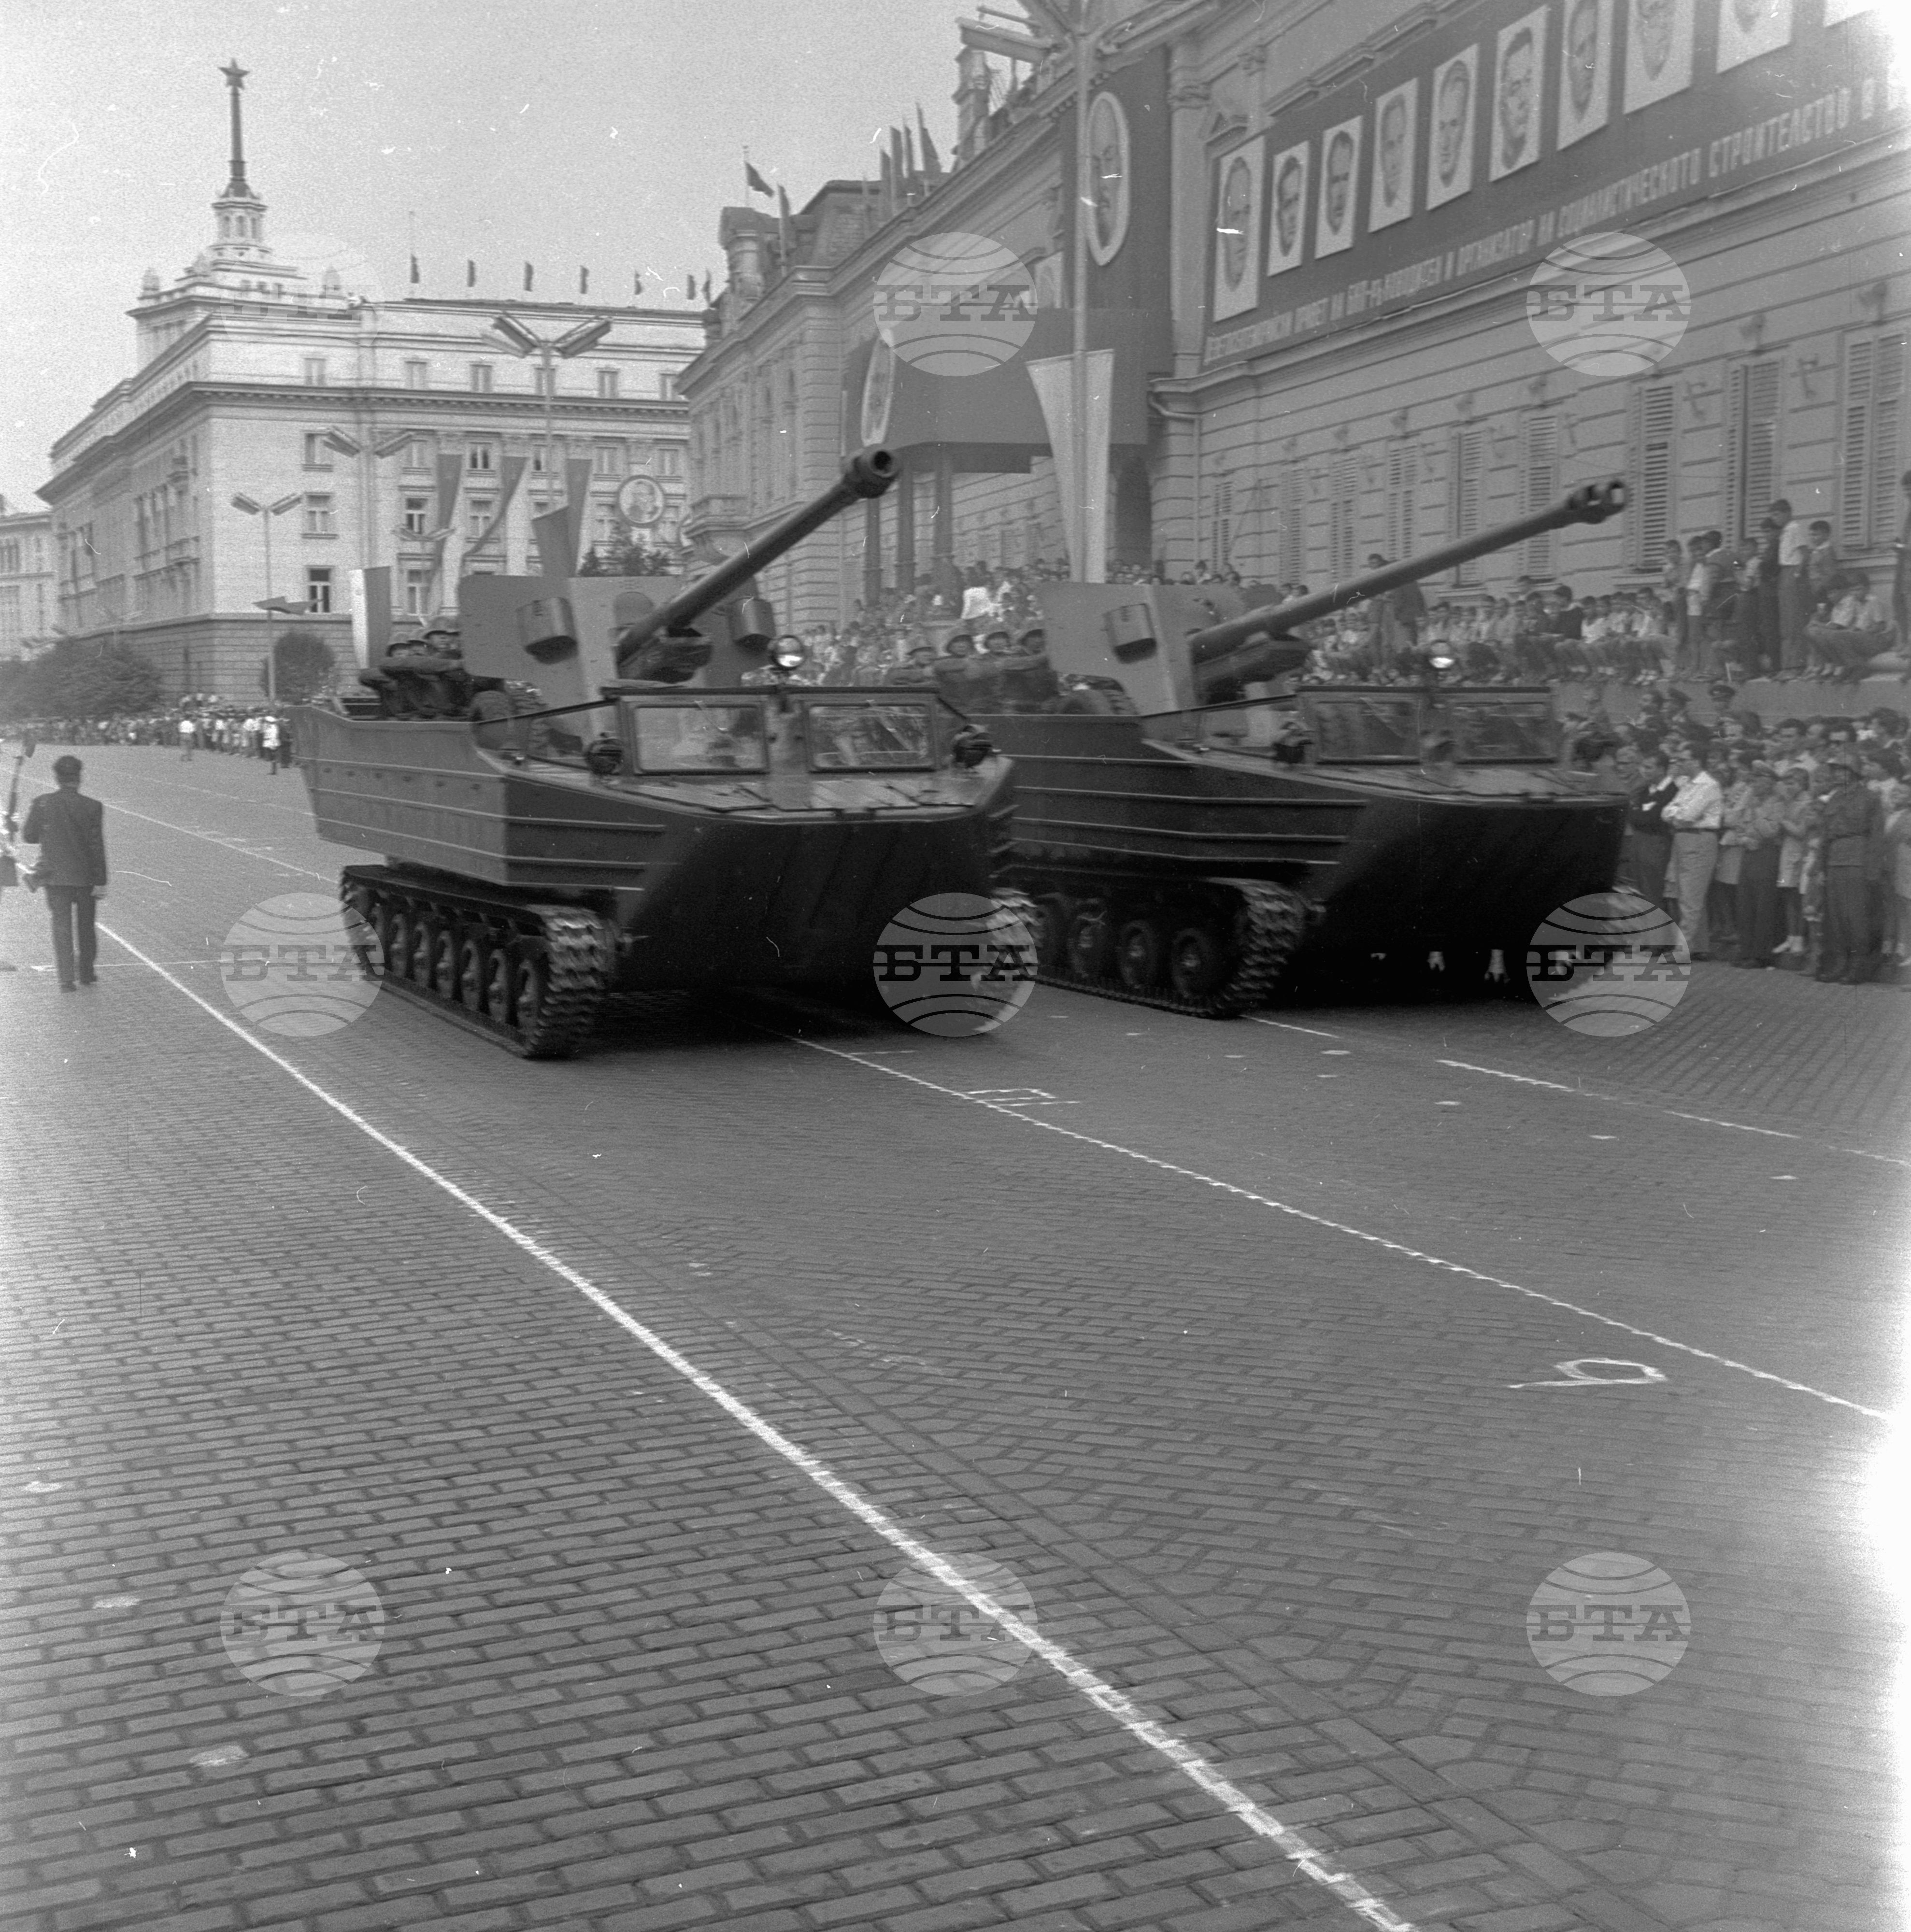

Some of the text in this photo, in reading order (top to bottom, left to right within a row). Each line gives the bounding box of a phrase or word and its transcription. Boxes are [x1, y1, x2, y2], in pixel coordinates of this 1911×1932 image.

[1444, 251, 1455, 281] И
[1456, 219, 1535, 276] ОРГАНИЗАТОР
[1537, 211, 1555, 246] НА
[1557, 148, 1701, 238] СОЦИАЛИСТИЧЕСКОТО
[1709, 87, 1851, 178] СТРОИТЕЛСТВО
